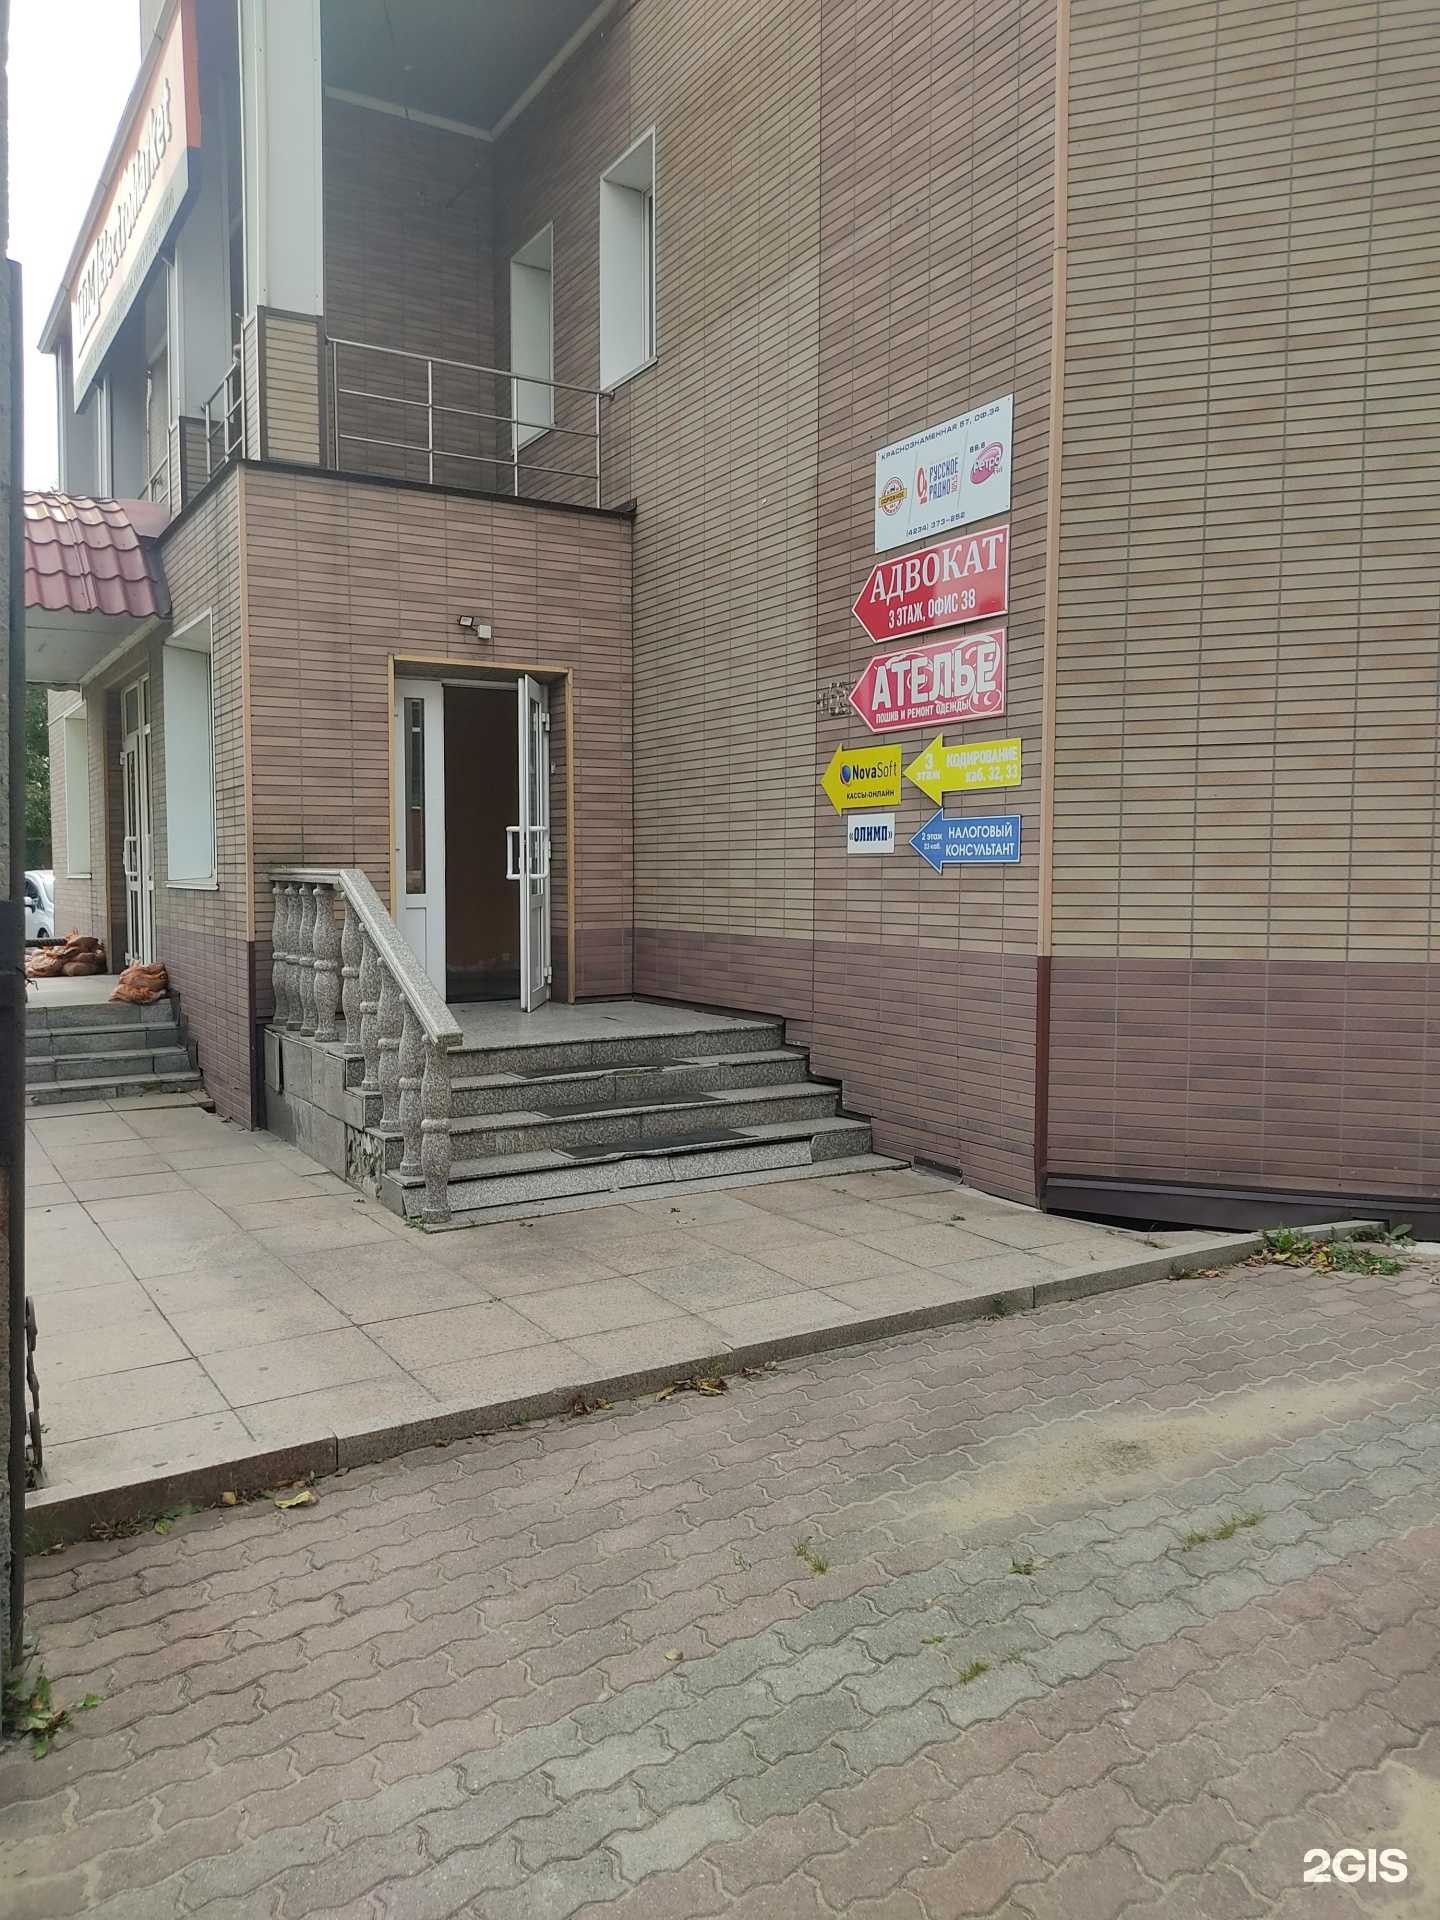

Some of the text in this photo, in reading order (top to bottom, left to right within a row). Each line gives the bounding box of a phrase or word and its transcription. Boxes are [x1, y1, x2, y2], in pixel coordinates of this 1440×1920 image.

[881, 426, 957, 460] КРАСНОЗНАМЕННАЯ
[929, 457, 958, 501] РУССКОЕ РАДИО
[870, 533, 1004, 606] АДВОКАТ
[888, 587, 976, 629] 3 ЭТАЖ, ОФИС 38
[872, 642, 998, 711] АТЕЛЬЕ
[875, 699, 970, 724] ПОШИВ И РЕМОНТ ОДЕЖДЫ
[925, 752, 934, 770] 3
[945, 746, 1018, 769] КОДИРОВАНИЕ
[852, 760, 897, 781] NovaSoft
[965, 767, 986, 783] каб.
[846, 789, 895, 800] КАССЫ-ОНЛАЙН
[849, 825, 893, 842] «ОЛИМП»
[921, 832, 943, 840] 2 этаж
[948, 821, 1013, 839] НАЛОГОВЫЙ
[945, 842, 1015, 857] КОНСУЛЬТАНТ
